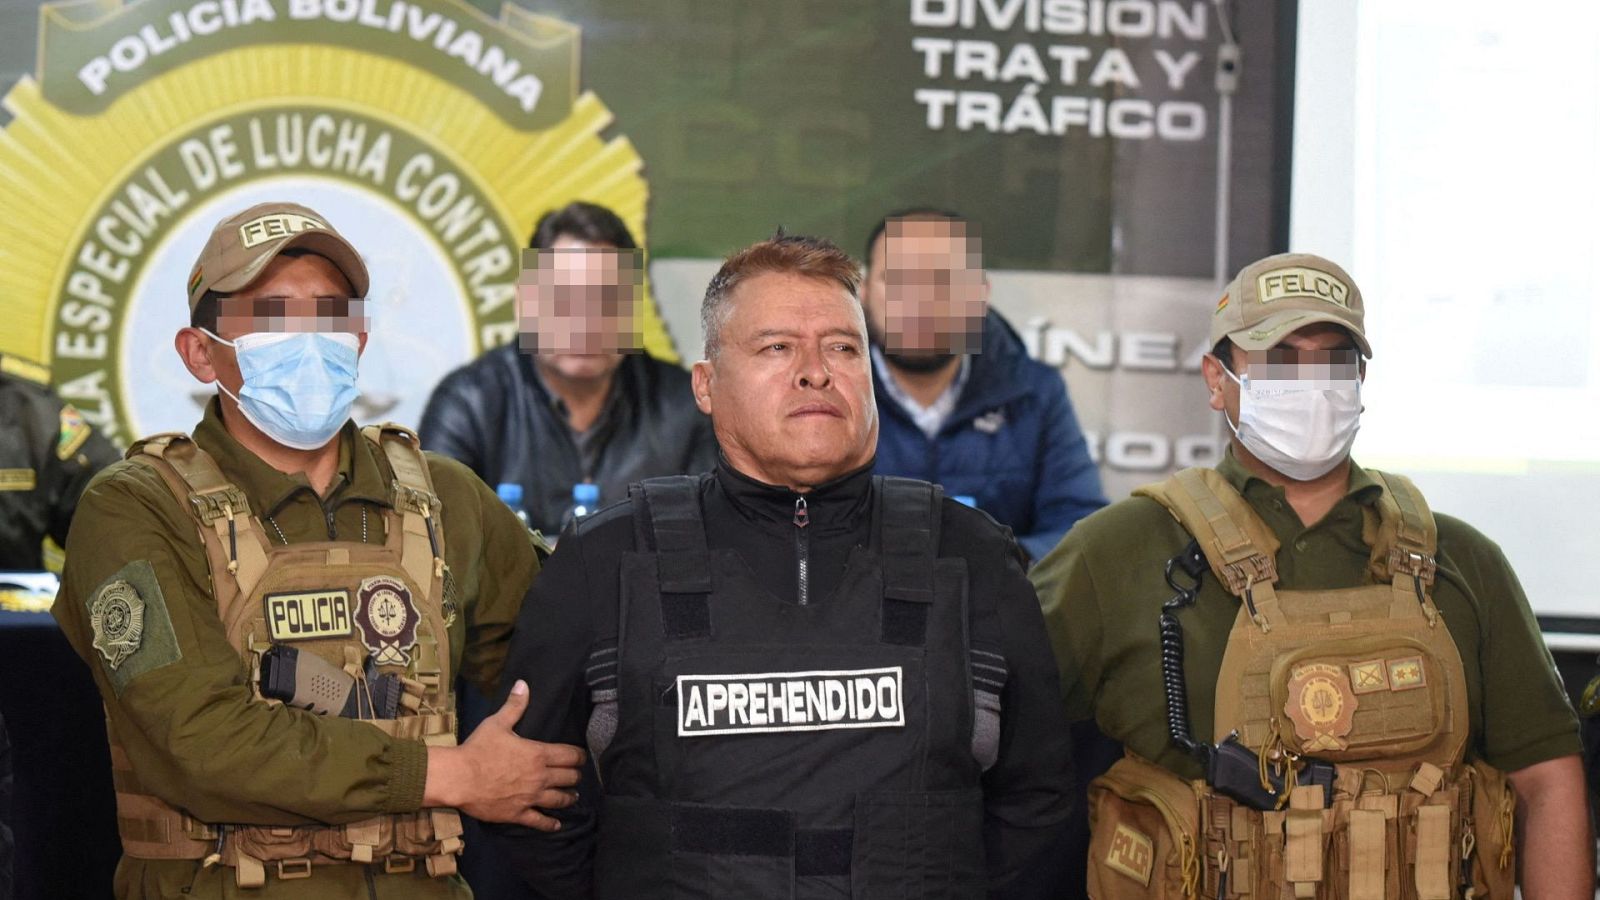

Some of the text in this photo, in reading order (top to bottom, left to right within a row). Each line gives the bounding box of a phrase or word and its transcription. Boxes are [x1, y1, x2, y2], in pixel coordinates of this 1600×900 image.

[288, 0, 543, 113] BOLIVIANA
[911, 38, 1202, 90] TRATA Y
[914, 83, 1207, 140] TRÁFICO
[55, 166, 190, 360] ESPECIAL
[179, 124, 244, 191] DE
[249, 113, 393, 185] LUCHA
[394, 153, 518, 317] CONTRA
[1265, 274, 1343, 304] FELCC
[272, 596, 348, 634] POLICIA
[685, 676, 898, 728] APREHENDIDO
